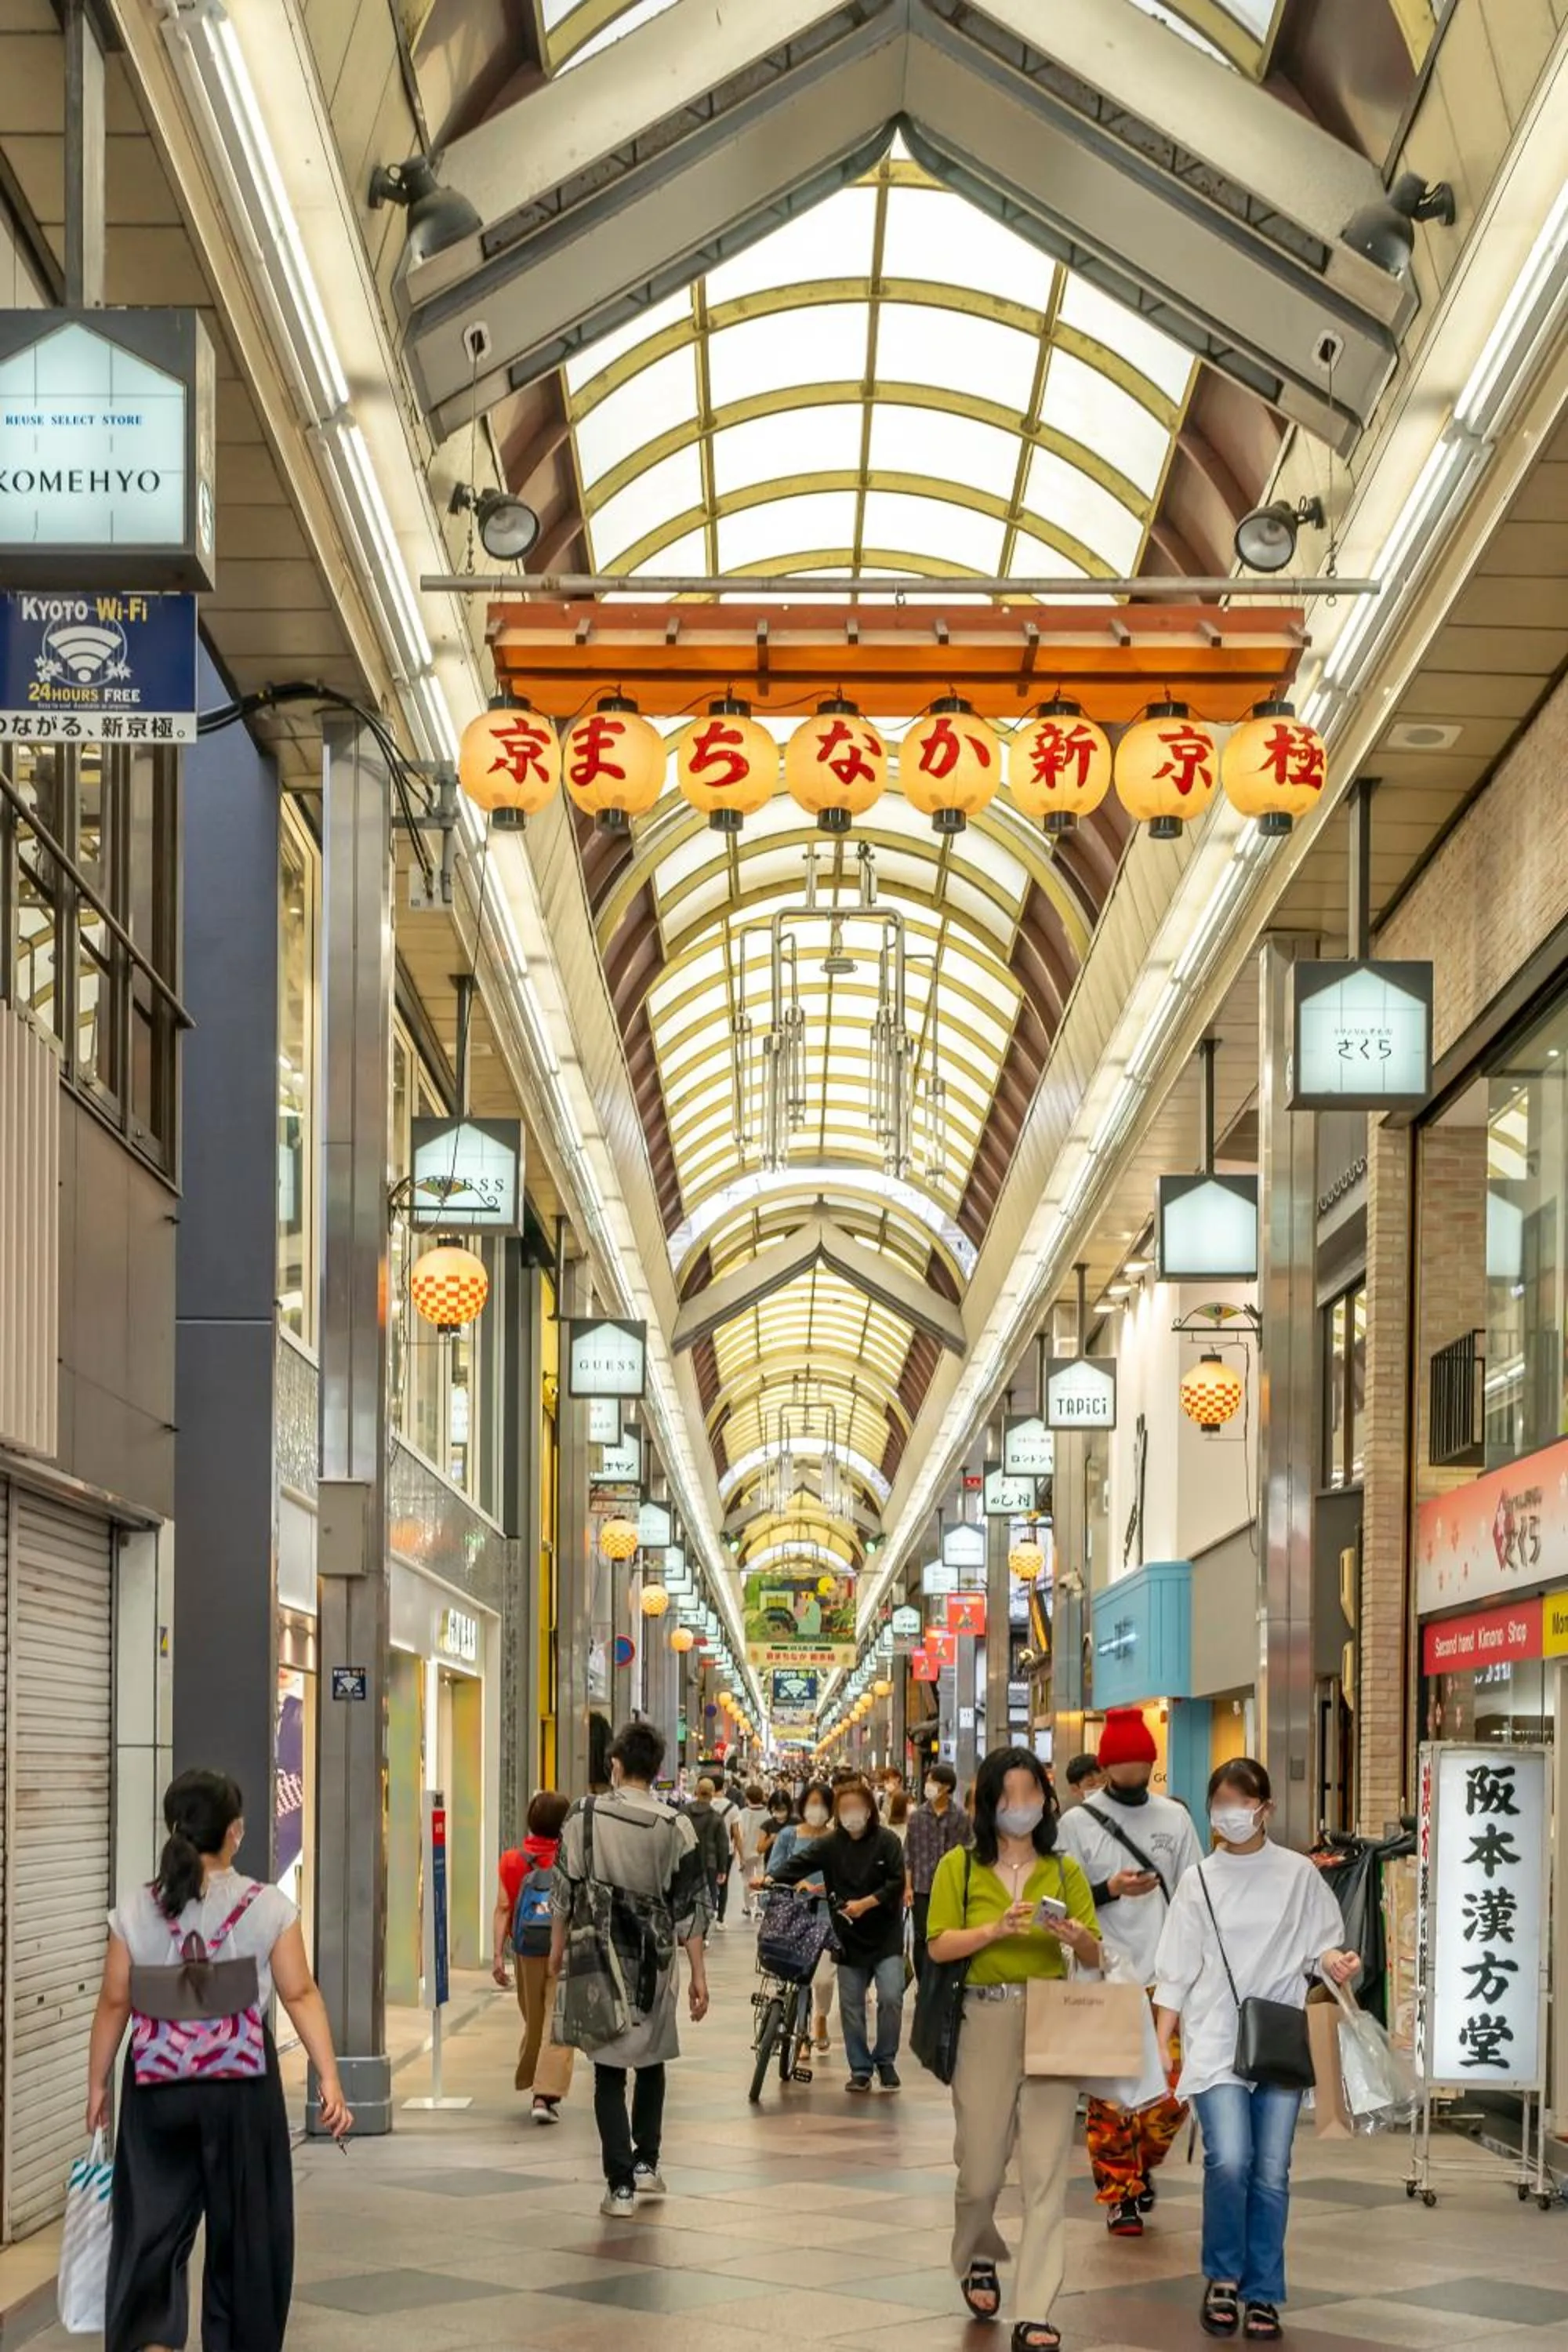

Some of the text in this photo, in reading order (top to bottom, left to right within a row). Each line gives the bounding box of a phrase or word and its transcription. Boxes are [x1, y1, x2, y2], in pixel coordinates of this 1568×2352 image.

[5, 415, 143, 426] REUSE SELECT STORE
[96, 597, 147, 622] Wi-Fi
[104, 688, 141, 703] FREE
[1337, 1038, 1392, 1060] さくら
[579, 1359, 636, 1371] GUESS
[1478, 1626, 1504, 1650] Kimono
[1508, 1621, 1527, 1646] Shop
[1459, 1764, 1521, 2069] 阪本漢方堂
